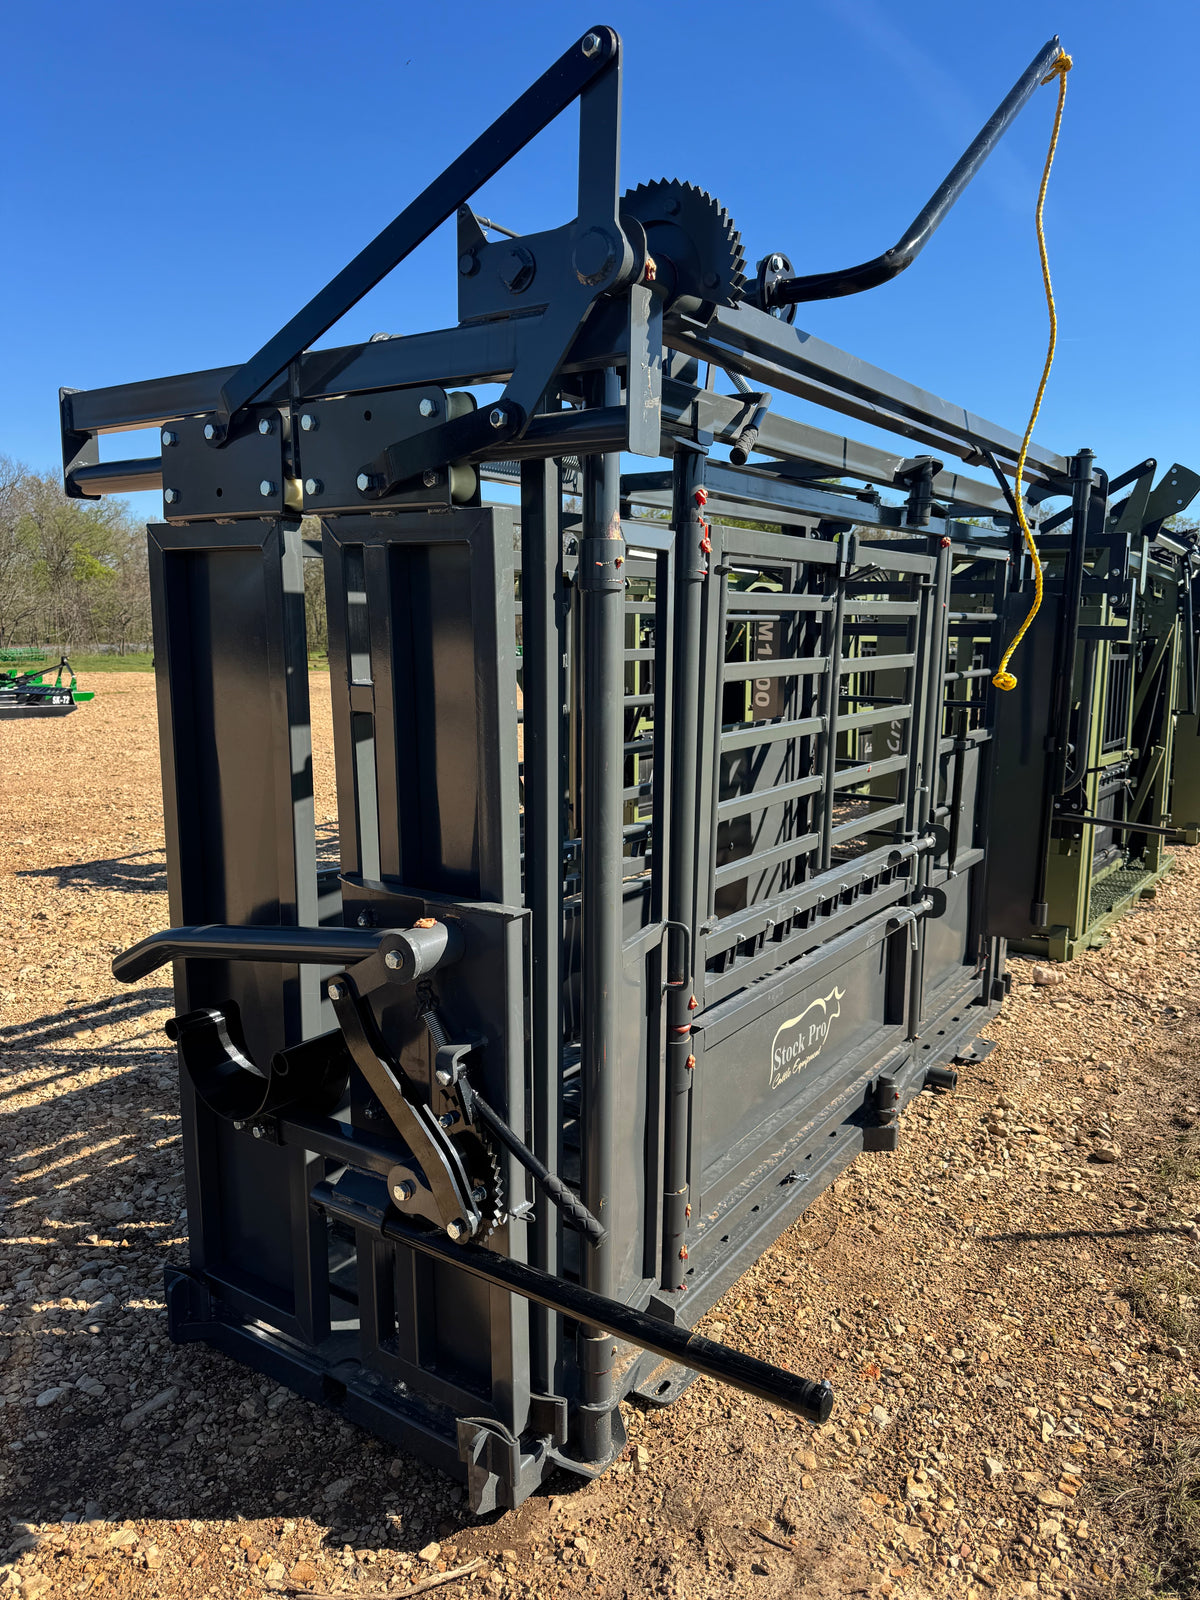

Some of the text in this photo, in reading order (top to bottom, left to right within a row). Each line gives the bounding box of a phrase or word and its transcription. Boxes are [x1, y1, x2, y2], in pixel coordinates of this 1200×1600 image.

[754, 621, 774, 707] M100
[52, 696, 70, 704] SK-72
[774, 1022, 827, 1071] Stock Pro
